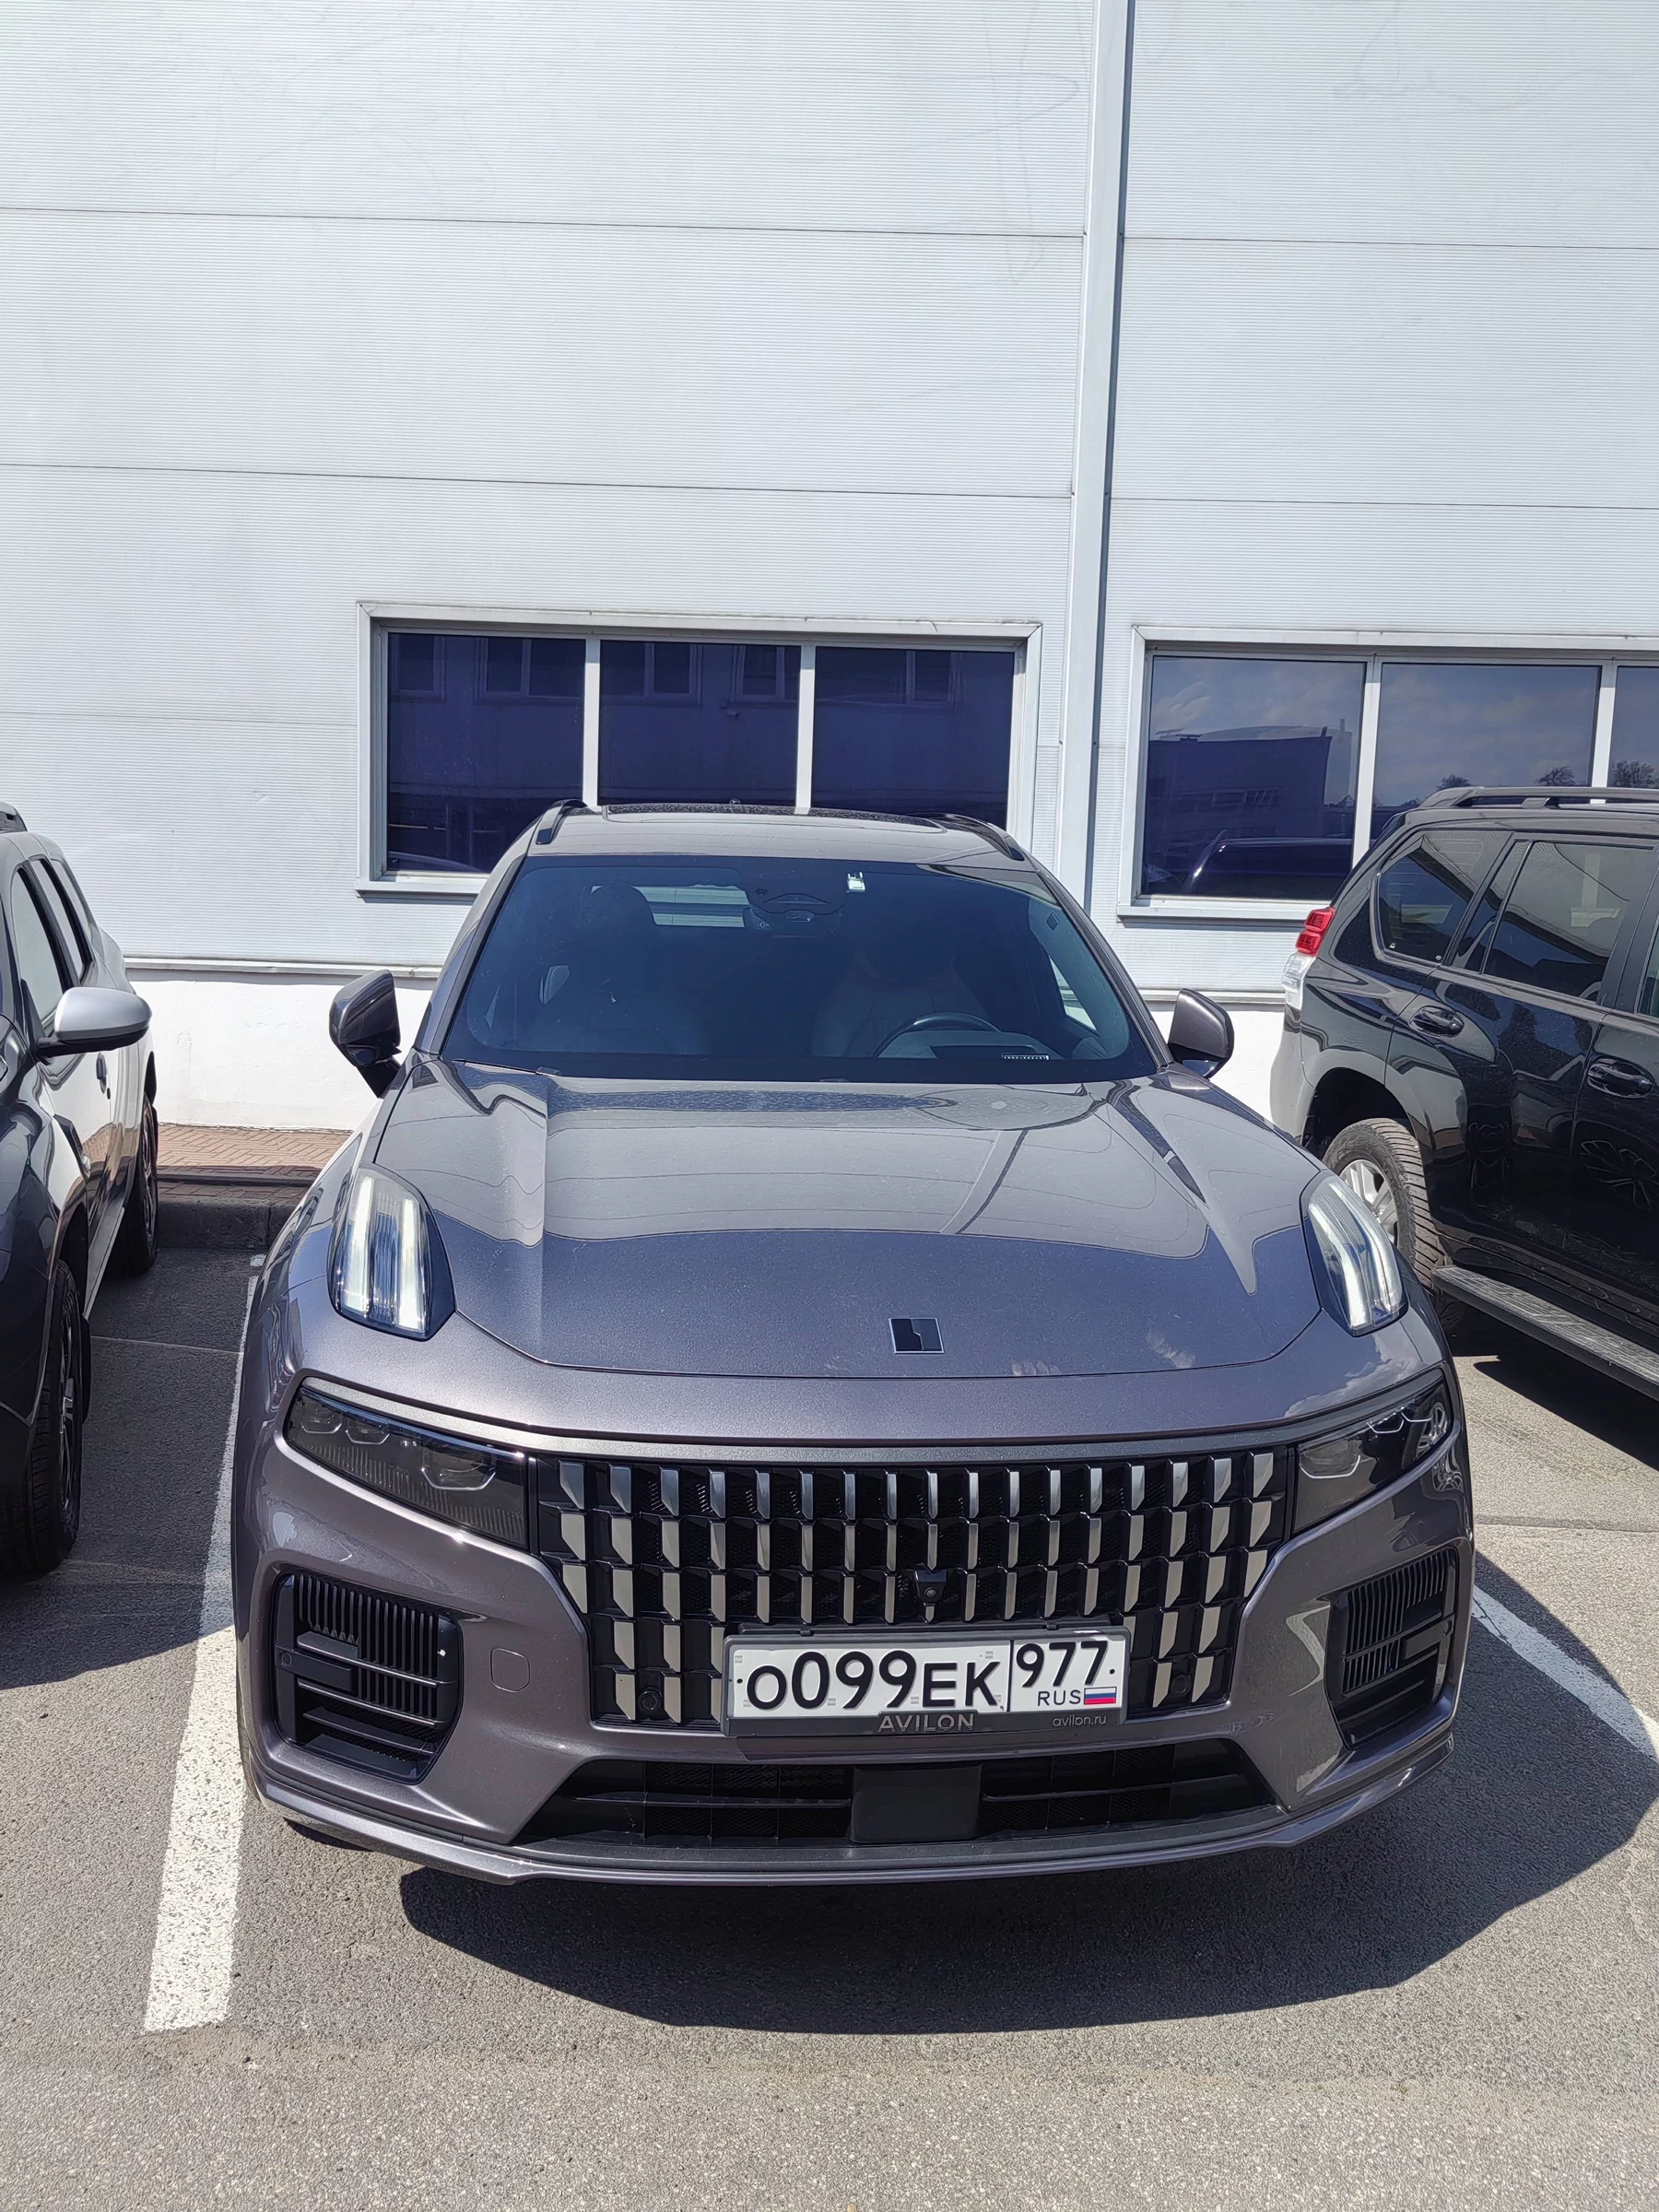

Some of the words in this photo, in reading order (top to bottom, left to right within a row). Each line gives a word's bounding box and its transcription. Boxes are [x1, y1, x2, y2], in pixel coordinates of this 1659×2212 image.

[1016, 1641, 1108, 1688] 977
[1038, 1689, 1081, 1706] RUS
[877, 1713, 974, 1733] AVILON
[1053, 1714, 1107, 1727] avilon.ru
